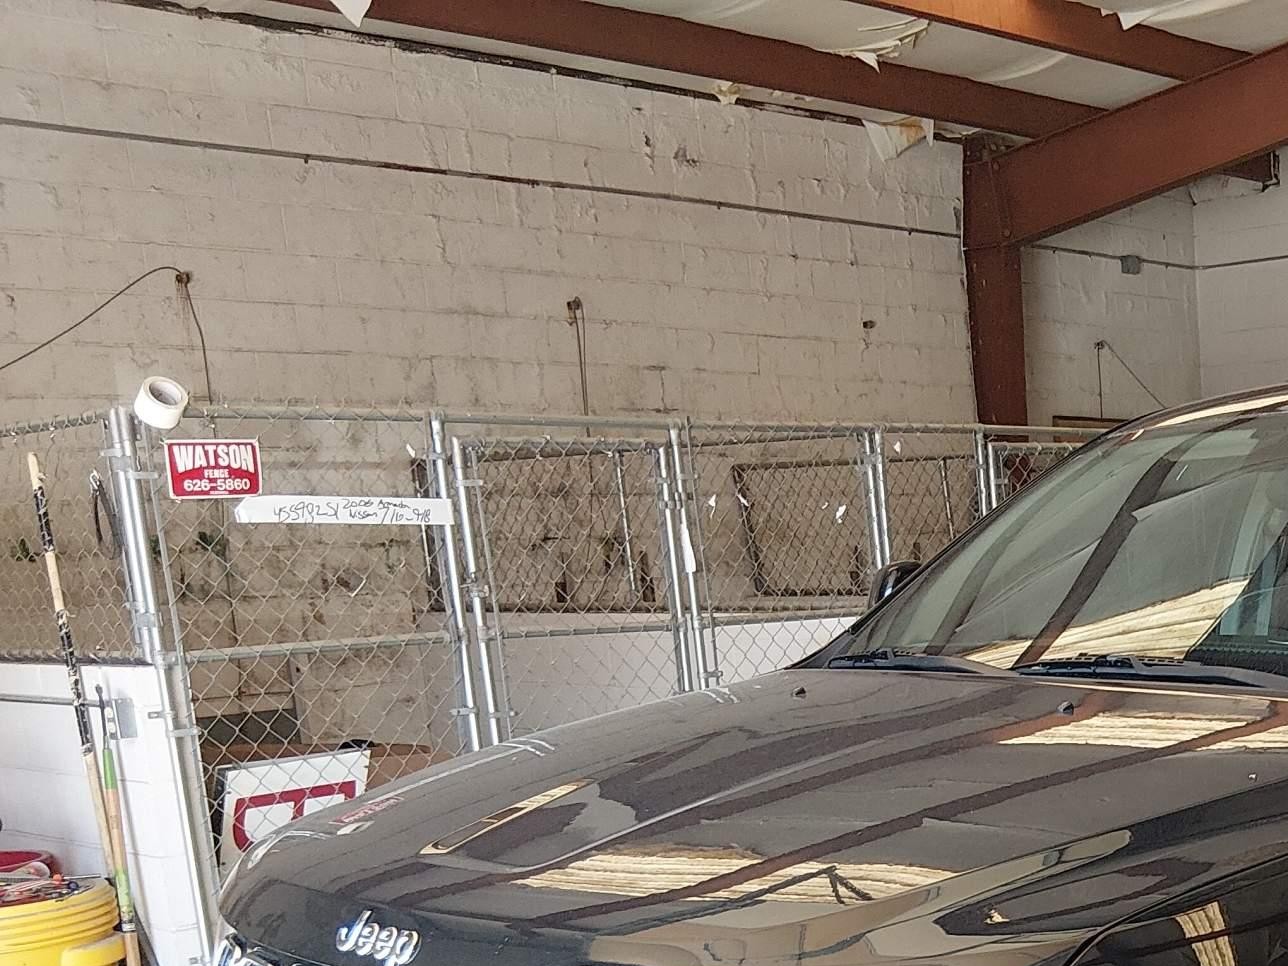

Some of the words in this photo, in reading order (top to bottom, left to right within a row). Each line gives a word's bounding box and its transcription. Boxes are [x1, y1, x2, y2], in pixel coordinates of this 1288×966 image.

[172, 444, 256, 474] WATSON
[203, 468, 230, 478] FENCE
[183, 478, 251, 492] 626-5860
